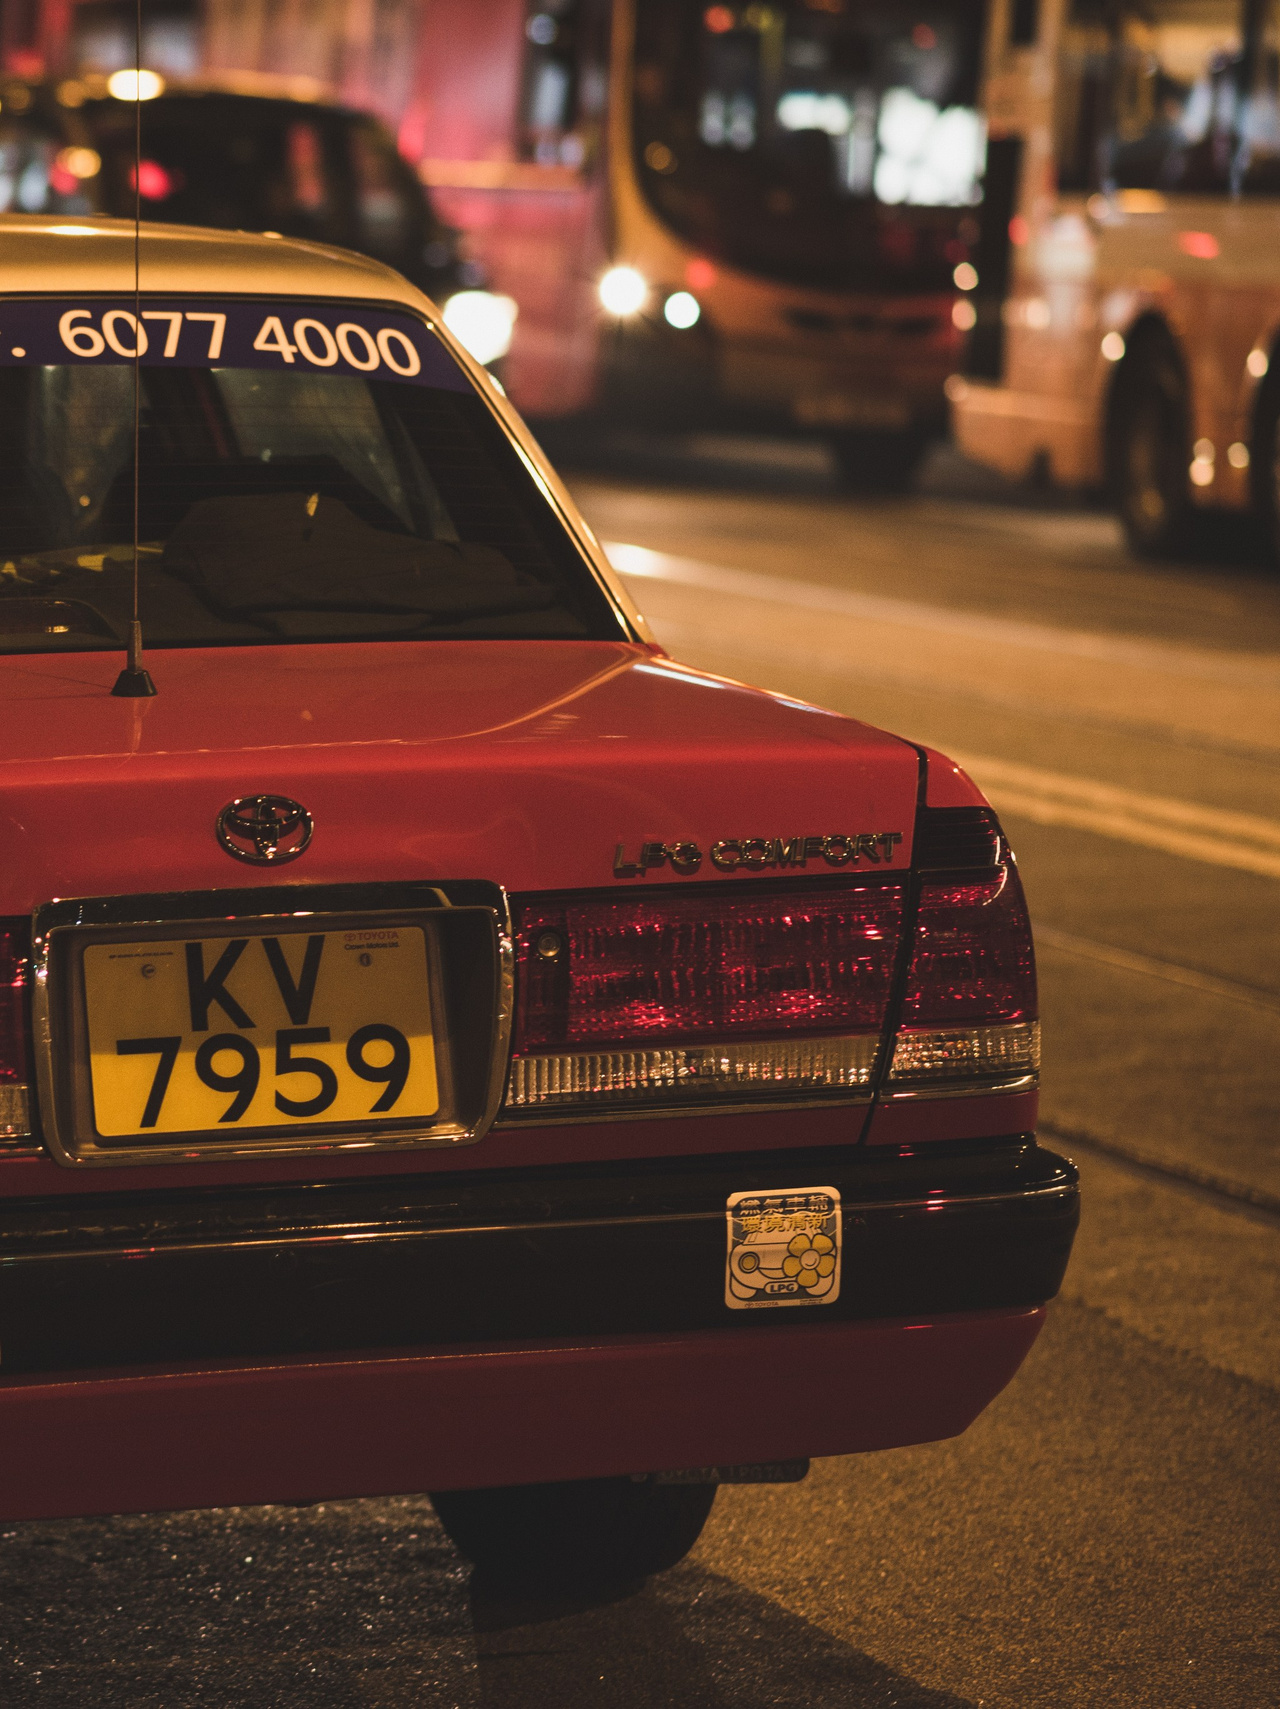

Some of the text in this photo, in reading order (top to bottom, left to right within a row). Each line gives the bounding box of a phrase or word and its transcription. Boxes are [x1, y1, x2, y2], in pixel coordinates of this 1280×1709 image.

[58, 308, 227, 360] 6077
[253, 315, 422, 377] 4000
[614, 832, 904, 878] LPG COMFORT
[357, 931, 399, 941] TOYOTA
[185, 934, 325, 1032] KV
[116, 1023, 411, 1128] 7959
[770, 1283, 795, 1293] LPG
